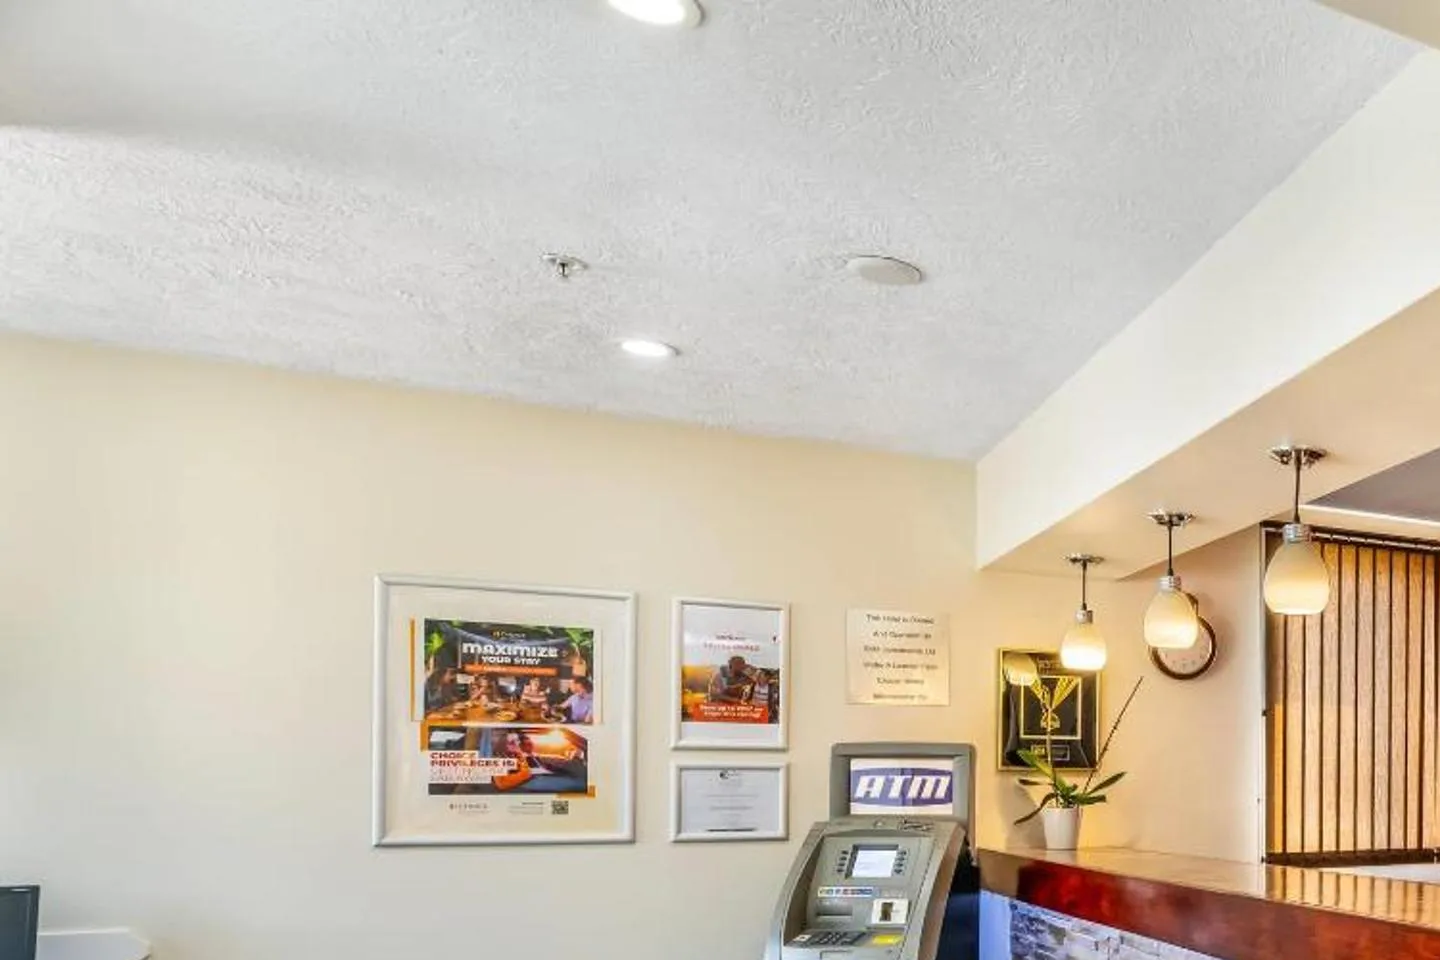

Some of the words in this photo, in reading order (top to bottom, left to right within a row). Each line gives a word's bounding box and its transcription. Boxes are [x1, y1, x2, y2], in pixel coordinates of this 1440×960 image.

[462, 642, 558, 657] MAXIMIZE
[481, 656, 512, 664] YOUR
[514, 657, 541, 665] STAY
[430, 759, 499, 767] PRIVILEGES
[854, 774, 951, 799] ATM
